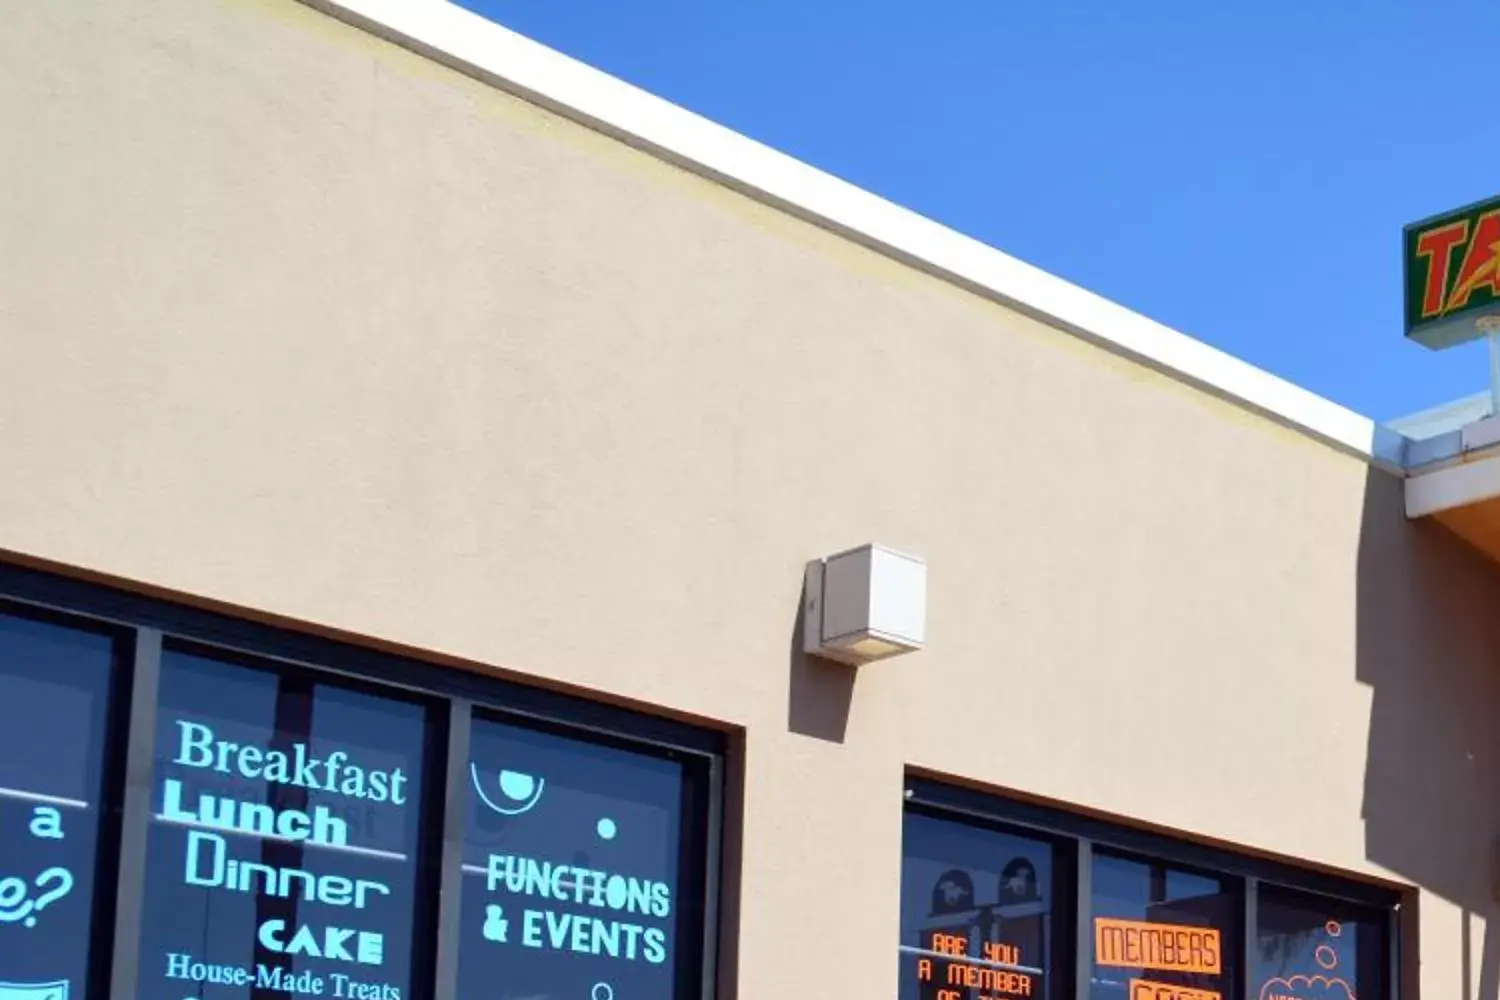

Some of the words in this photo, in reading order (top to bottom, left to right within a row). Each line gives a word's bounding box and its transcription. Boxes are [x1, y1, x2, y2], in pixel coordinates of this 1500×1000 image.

[173, 719, 408, 804] Breakfast
[29, 807, 65, 838] a
[162, 779, 348, 847] Lunch
[185, 830, 390, 909] Dinner
[487, 854, 670, 917] FUNCTIONS
[258, 919, 384, 965] CAKE
[483, 904, 509, 943] &
[522, 909, 666, 963] EVENTS
[932, 933, 967, 958] ARE
[984, 941, 1019, 966] YOU
[1101, 926, 1217, 967] MEMBERS
[165, 953, 323, 994] House-Made
[918, 959, 931, 981] A
[948, 963, 1031, 996] MEMBER
